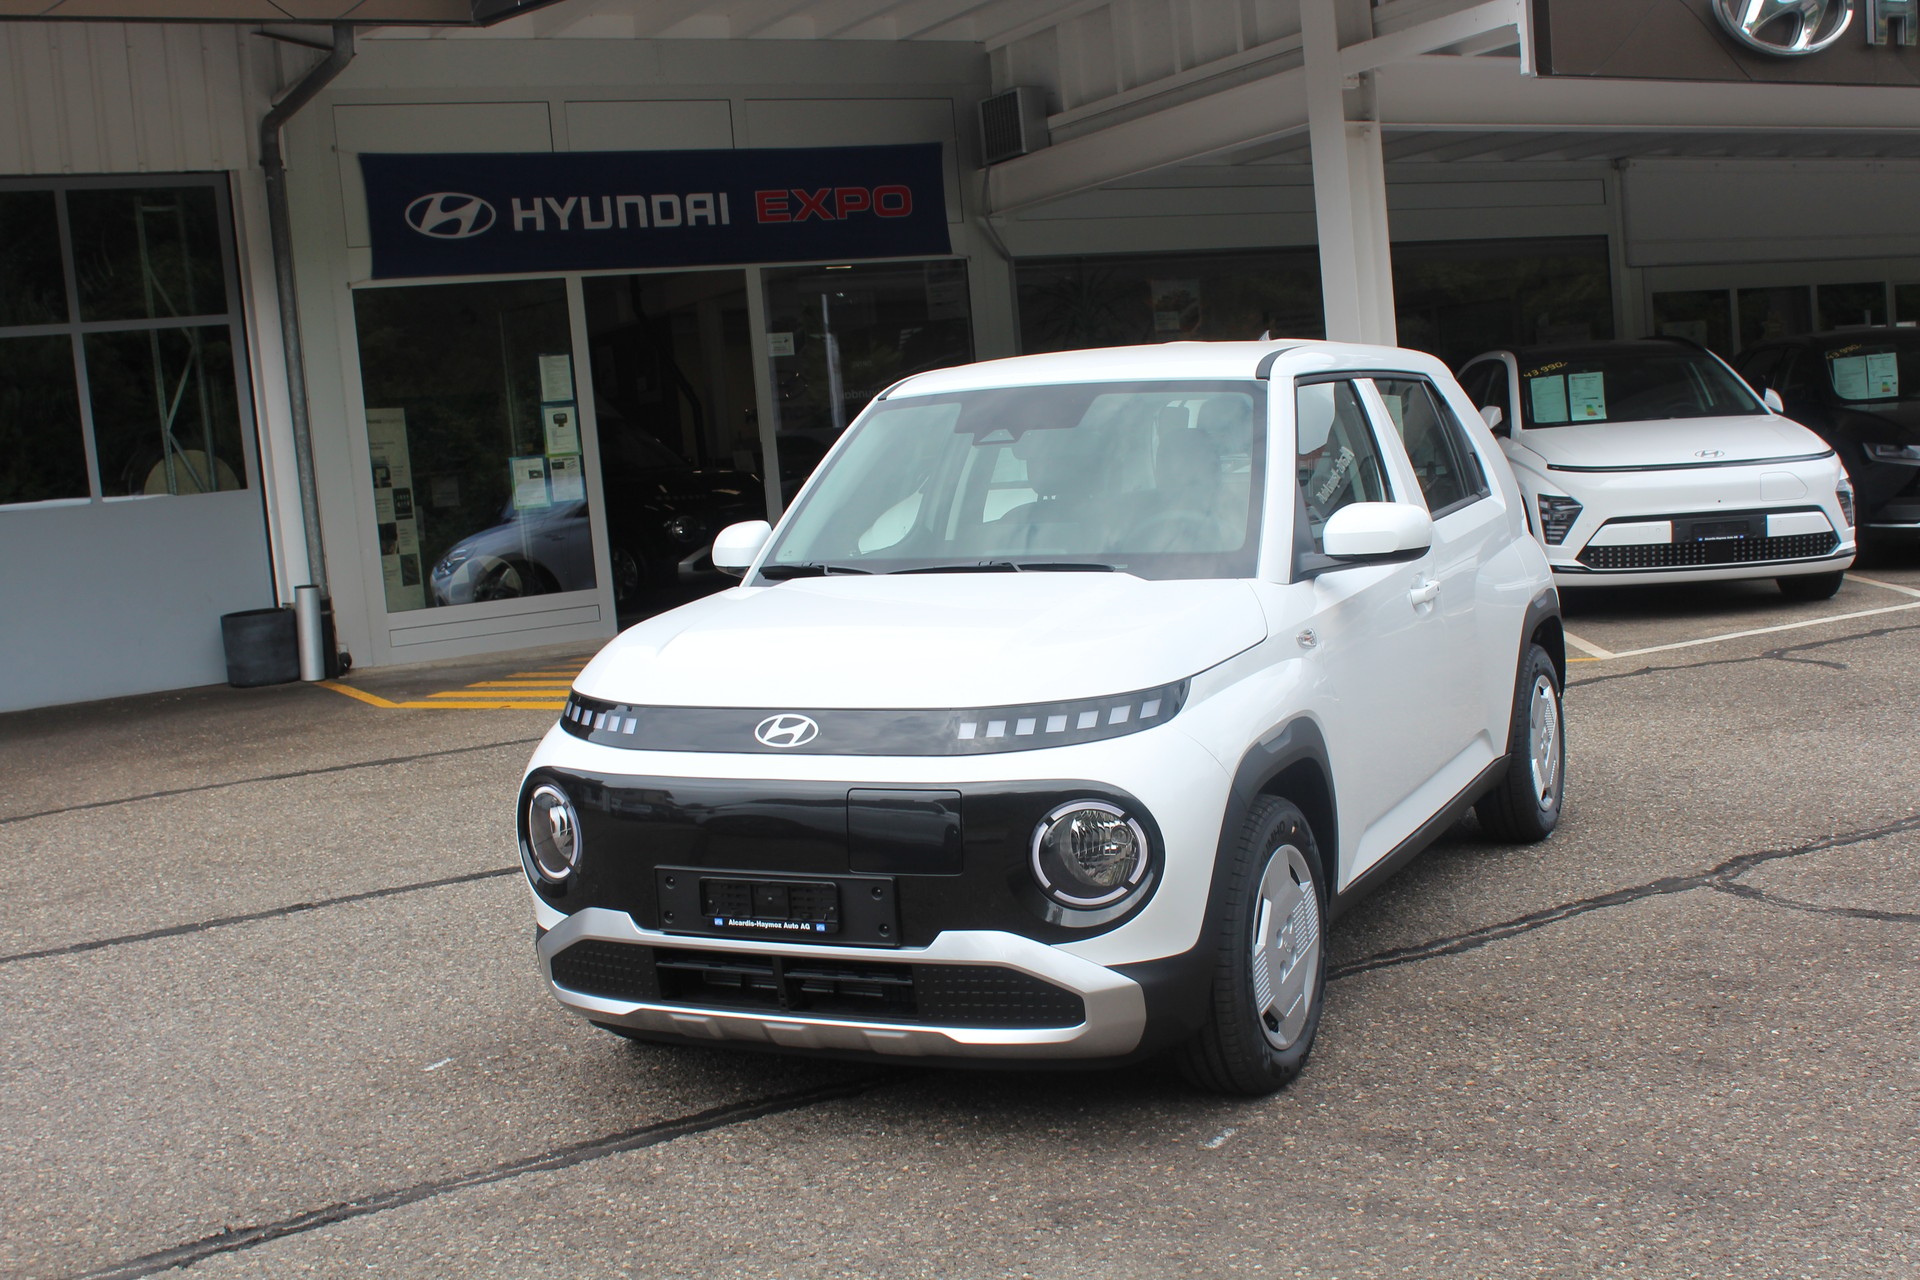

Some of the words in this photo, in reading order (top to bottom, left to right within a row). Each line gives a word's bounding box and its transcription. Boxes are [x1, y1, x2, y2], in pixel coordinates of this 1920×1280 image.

[512, 192, 730, 232] HYUNDAI
[755, 185, 912, 223] EXPO
[783, 921, 799, 930] Auto
[800, 922, 811, 931] AG
